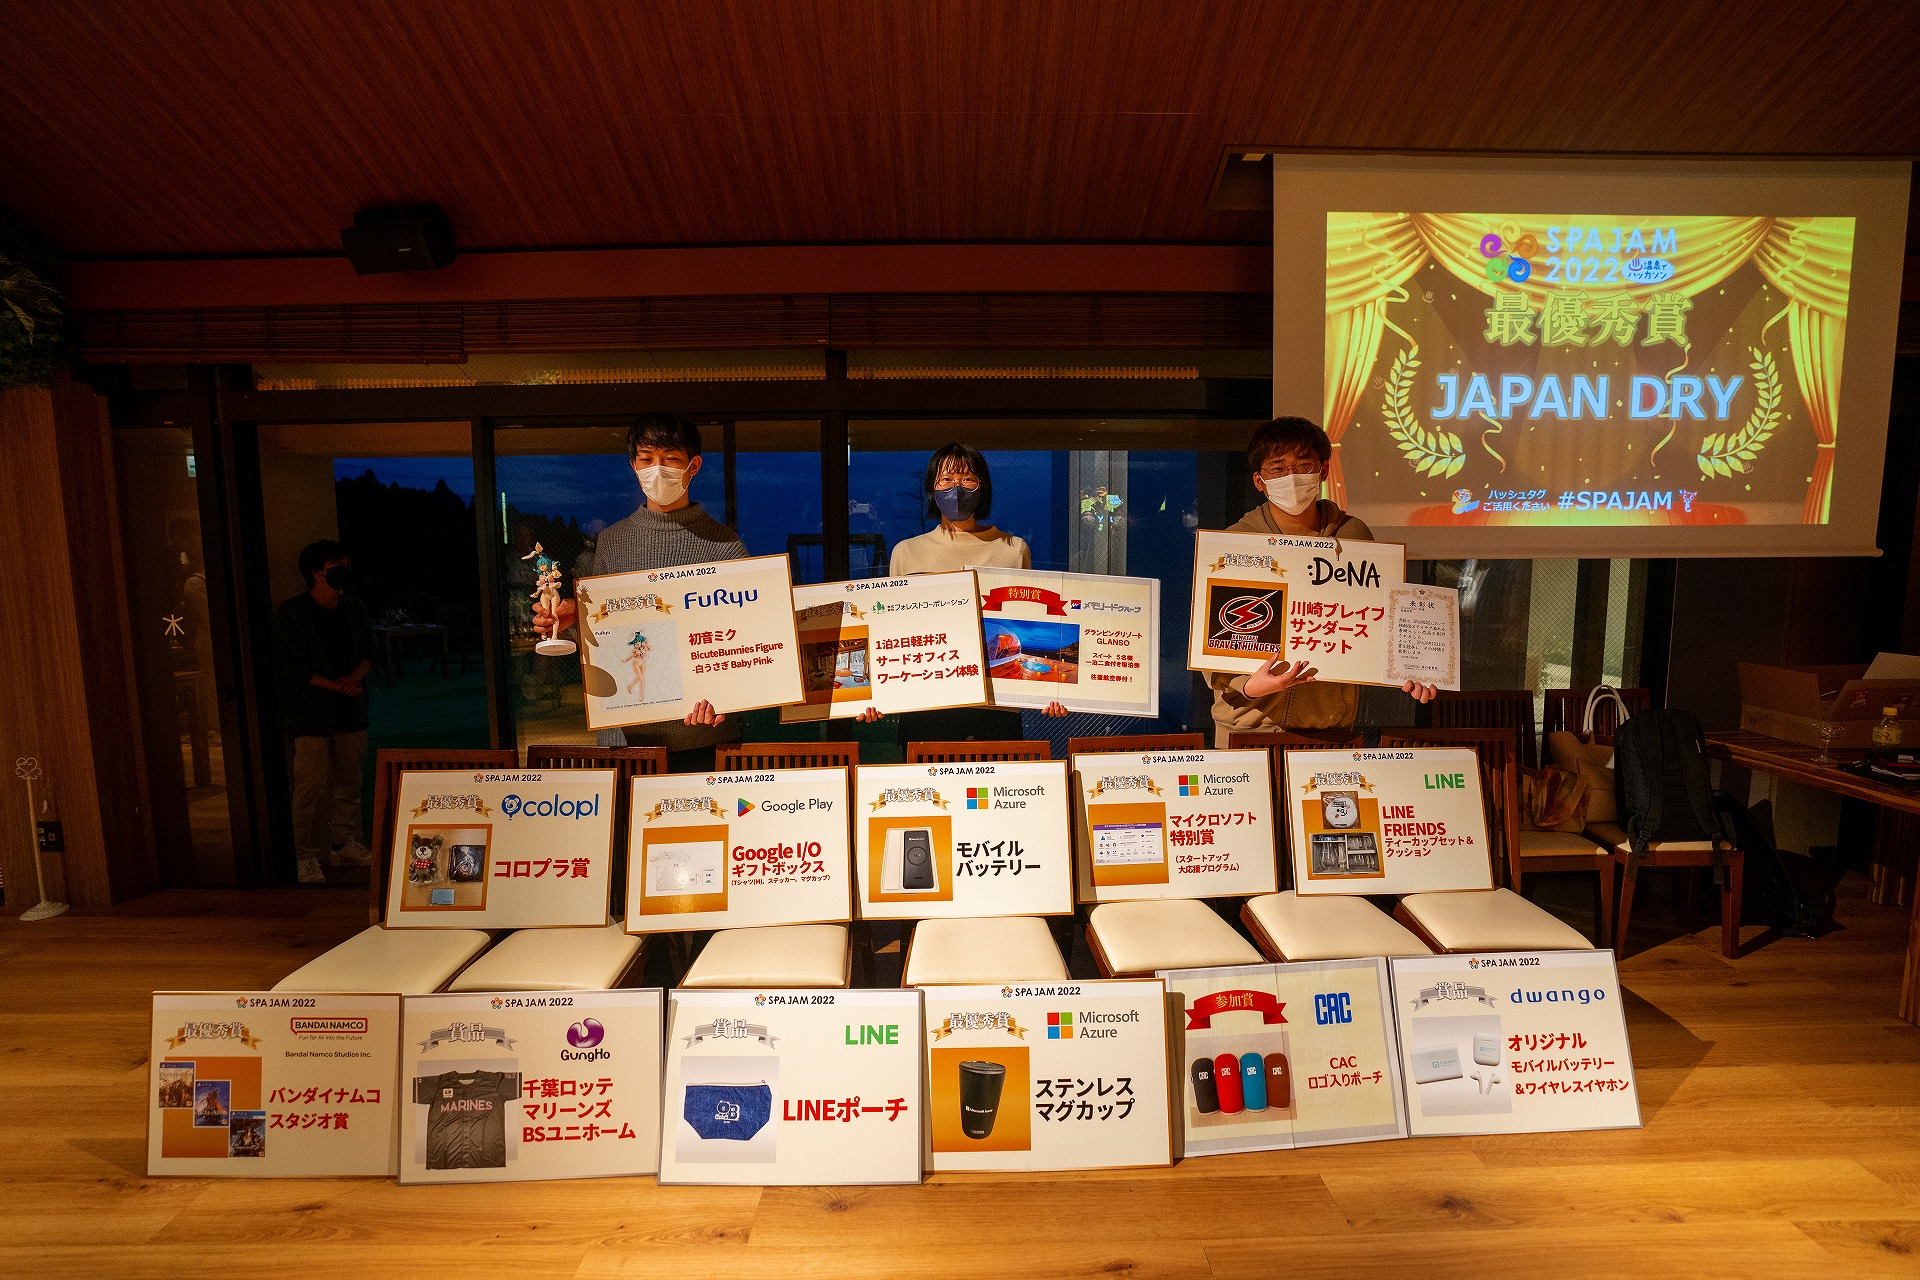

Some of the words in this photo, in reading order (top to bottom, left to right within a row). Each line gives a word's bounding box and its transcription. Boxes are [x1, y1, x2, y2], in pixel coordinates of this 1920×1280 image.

[1544, 256, 1620, 283] 2022
[1485, 290, 1694, 346] 最優秀賞
[1431, 374, 1610, 420] JAPAN
[1629, 375, 1744, 420] DRY
[1488, 489, 1547, 501] ハッシュタグ
[1557, 491, 1673, 511] #SPAJAM
[1483, 501, 1550, 512] ご活用ください
[1314, 540, 1334, 549] 2022
[1223, 552, 1274, 568] 最優秀賞
[696, 566, 717, 576] 2022
[889, 579, 908, 588] 2022
[684, 588, 759, 609] FuRyu
[1008, 587, 1041, 601] 特別賞
[605, 593, 659, 613] 最優秀賞
[1084, 629, 1143, 639] グランピングリゾート
[1290, 617, 1369, 639] サンダース
[688, 628, 737, 646] 初音ミク
[875, 633, 948, 650] 1泊2日軽井沢
[1096, 638, 1130, 646] GLANSO
[1289, 635, 1352, 655] チケット
[690, 644, 755, 661] BicuteBunnies
[755, 641, 784, 654] Figure
[1208, 639, 1236, 650] BRAVE
[1236, 641, 1280, 653] THUNDERS
[692, 661, 729, 675] -白うさぎ
[730, 657, 752, 670] Baby
[753, 656, 775, 667] Pink-
[876, 649, 960, 667] サードオフィス
[877, 664, 979, 684] ワーケーション体験
[521, 774, 542, 782] 2022
[754, 774, 775, 783] 2022
[1101, 774, 1149, 790] 最優秀賞
[1203, 772, 1250, 784] Microsoft
[1314, 771, 1361, 786] 最優秀賞
[1424, 773, 1465, 789] LINE
[883, 787, 936, 802] 最優秀賞
[993, 786, 1045, 797] Microsoft
[1204, 786, 1234, 796] Azure
[426, 794, 479, 810] 最優秀賞
[523, 793, 599, 820] colopl
[660, 796, 713, 813] 最優秀賞
[761, 800, 806, 813] Google
[808, 798, 833, 811] Play
[994, 799, 1027, 809] Azure
[1169, 811, 1257, 828] マイクロソフト
[1382, 805, 1415, 819] LINE
[1170, 829, 1215, 846] 特別賞
[1384, 822, 1447, 836] FRIENDS
[732, 842, 794, 863] Google
[797, 841, 822, 861] I/O
[956, 840, 1024, 858] モバイル
[1385, 848, 1432, 858] クッション
[494, 857, 590, 879] コロプラ賞
[731, 860, 825, 877] ギフトボックス
[956, 859, 1041, 877] バッテリー
[1519, 957, 1540, 966] 2022
[1057, 986, 1081, 995] 2022
[1435, 981, 1469, 1001] 賞品
[1510, 988, 1605, 1005] dwango
[292, 998, 316, 1008] 2022
[549, 997, 574, 1007] 2022
[811, 995, 835, 1005] 2022
[1215, 993, 1254, 1009] 参加賞
[1314, 992, 1352, 1025] CAC
[295, 1021, 328, 1029] BANDAI
[329, 1021, 364, 1029] NAMCO
[949, 1011, 1010, 1030] 最優秀賞
[1079, 1010, 1140, 1024] Microsoft
[183, 1022, 245, 1040] 最優秀賞
[448, 1022, 486, 1042] 賞品
[712, 1018, 749, 1039] 賞品
[845, 1025, 899, 1045] LINE
[1079, 1027, 1118, 1039] Azure
[1507, 1032, 1587, 1051] オリジナル
[560, 1049, 611, 1062] GungHo
[1329, 1056, 1357, 1069] CAC
[1511, 1057, 1615, 1073] モバイルバッテリー
[522, 1077, 613, 1098] 千葉ロッテ
[1035, 1077, 1135, 1098] ステンレス
[1308, 1070, 1383, 1089] ロゴ入りポーチ
[269, 1086, 381, 1104] バンダイナムコ
[440, 1099, 493, 1113] MARINES
[522, 1099, 613, 1120] マリーンズ
[783, 1096, 908, 1122] LINEポーチ
[1035, 1097, 1136, 1122] マグカップ
[269, 1112, 349, 1130] スタジオ賞
[522, 1122, 636, 1143] BSユニホーム
